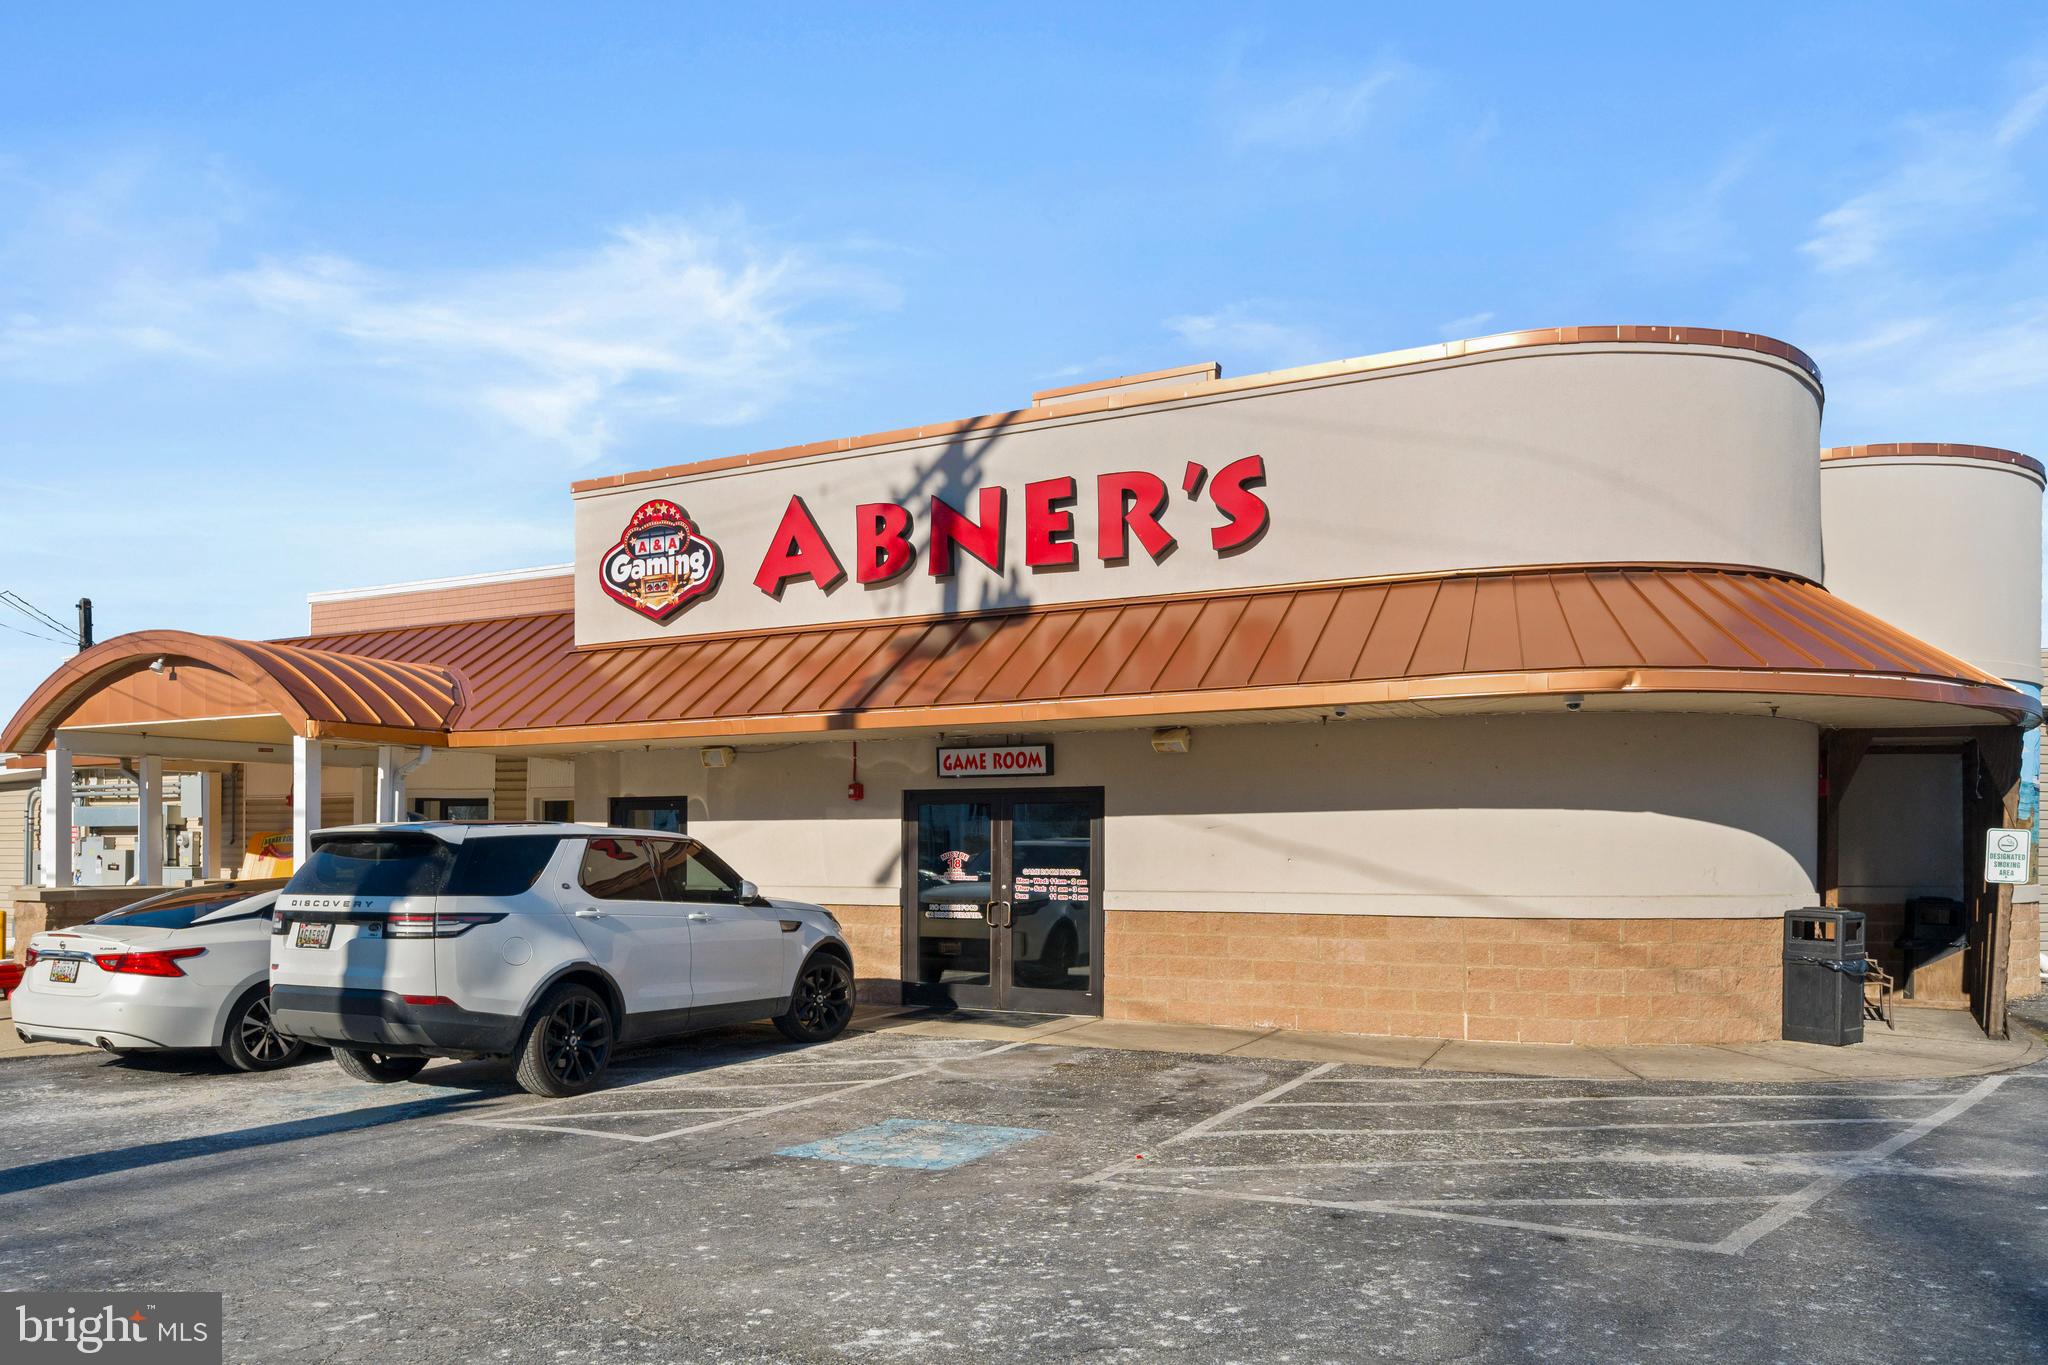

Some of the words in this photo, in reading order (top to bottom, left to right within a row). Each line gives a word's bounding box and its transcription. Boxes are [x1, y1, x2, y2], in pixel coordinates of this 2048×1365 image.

[753, 455, 1270, 602] ABNER'S
[610, 548, 705, 583] Gaming
[943, 752, 987, 771] GAME
[993, 751, 1043, 769] ROOM
[1989, 852, 2026, 861] DESIGNATED
[947, 858, 961, 868] 18
[1993, 861, 2021, 869] SMOKING
[291, 899, 374, 908] DISCOVERY
